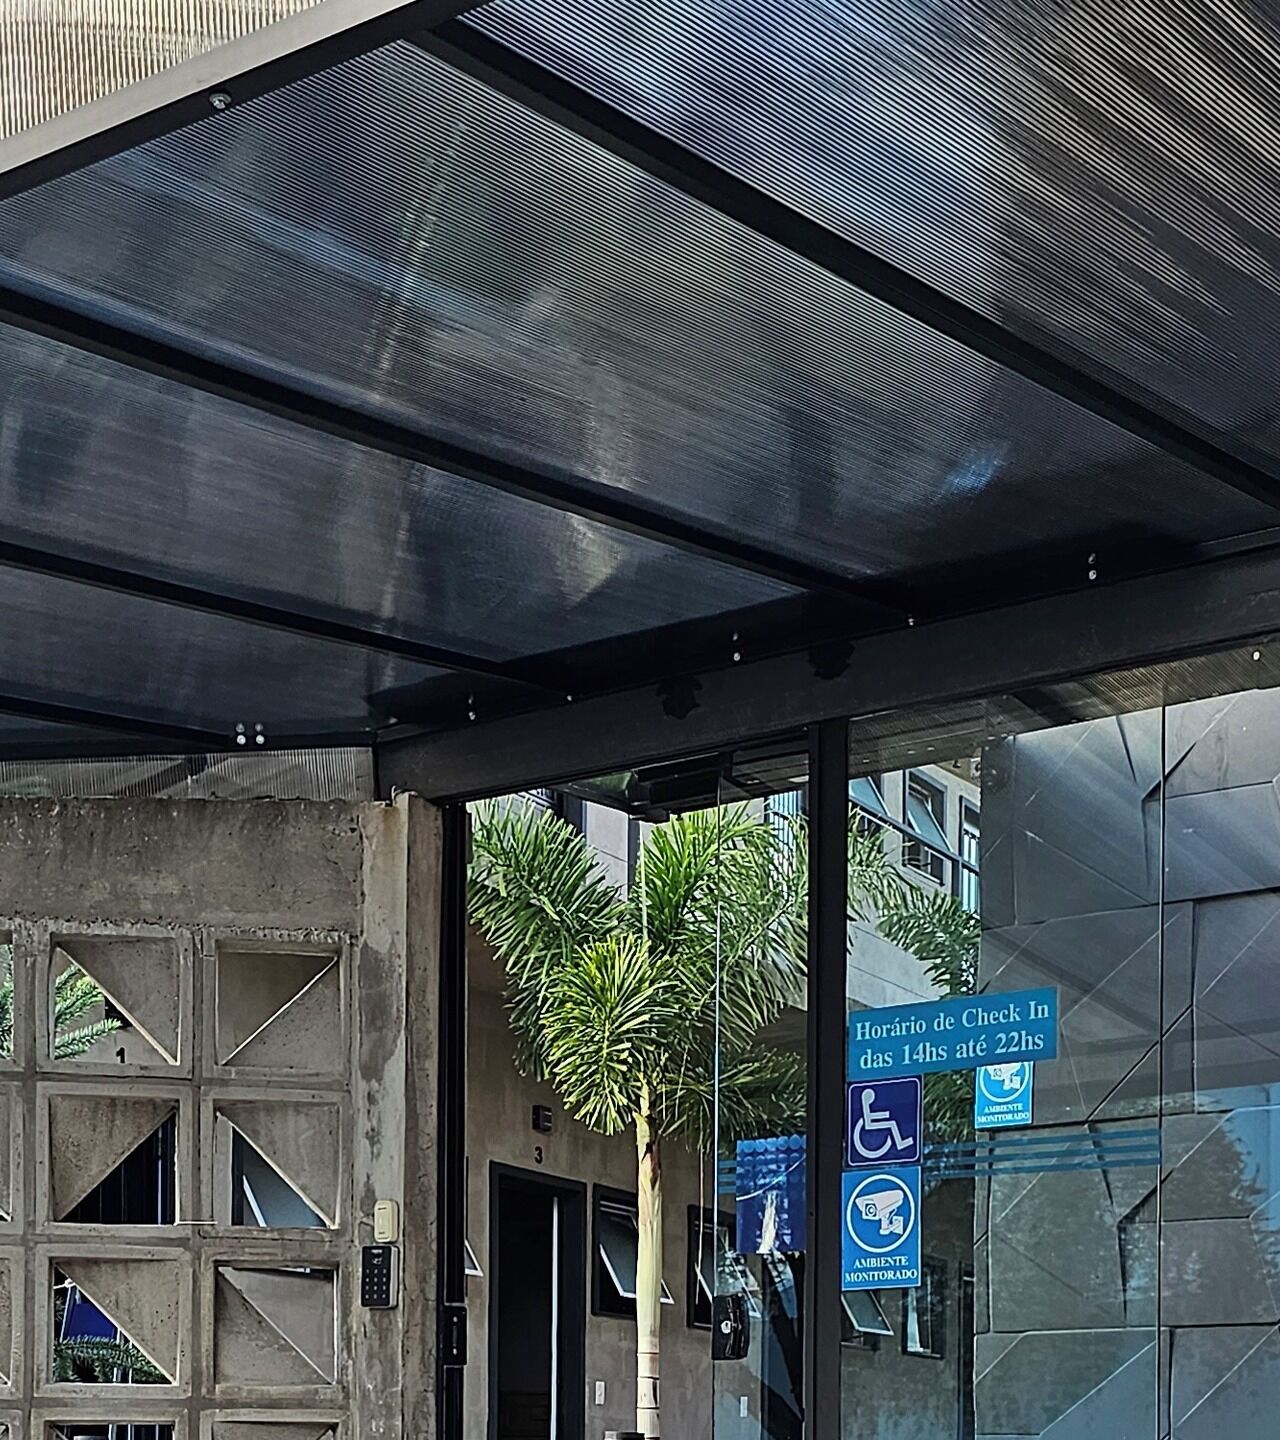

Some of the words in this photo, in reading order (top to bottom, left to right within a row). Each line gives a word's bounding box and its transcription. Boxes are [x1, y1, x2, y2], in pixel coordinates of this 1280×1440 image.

[855, 1015, 926, 1041] Horário
[933, 1012, 955, 1031] de
[961, 1003, 1020, 1028] Check
[1028, 1000, 1049, 1020] In
[116, 1047, 125, 1064] 1
[859, 1049, 893, 1070] das
[901, 1042, 948, 1065] 14hs
[955, 1034, 987, 1060] até
[994, 1030, 1044, 1055] 22hs
[984, 1103, 1023, 1113] AMBIENTE
[977, 1112, 1029, 1122] MONITORADO
[534, 1146, 543, 1165] 3
[854, 1256, 909, 1269] AMBIENTE
[845, 1269, 918, 1283] MONITORADO
